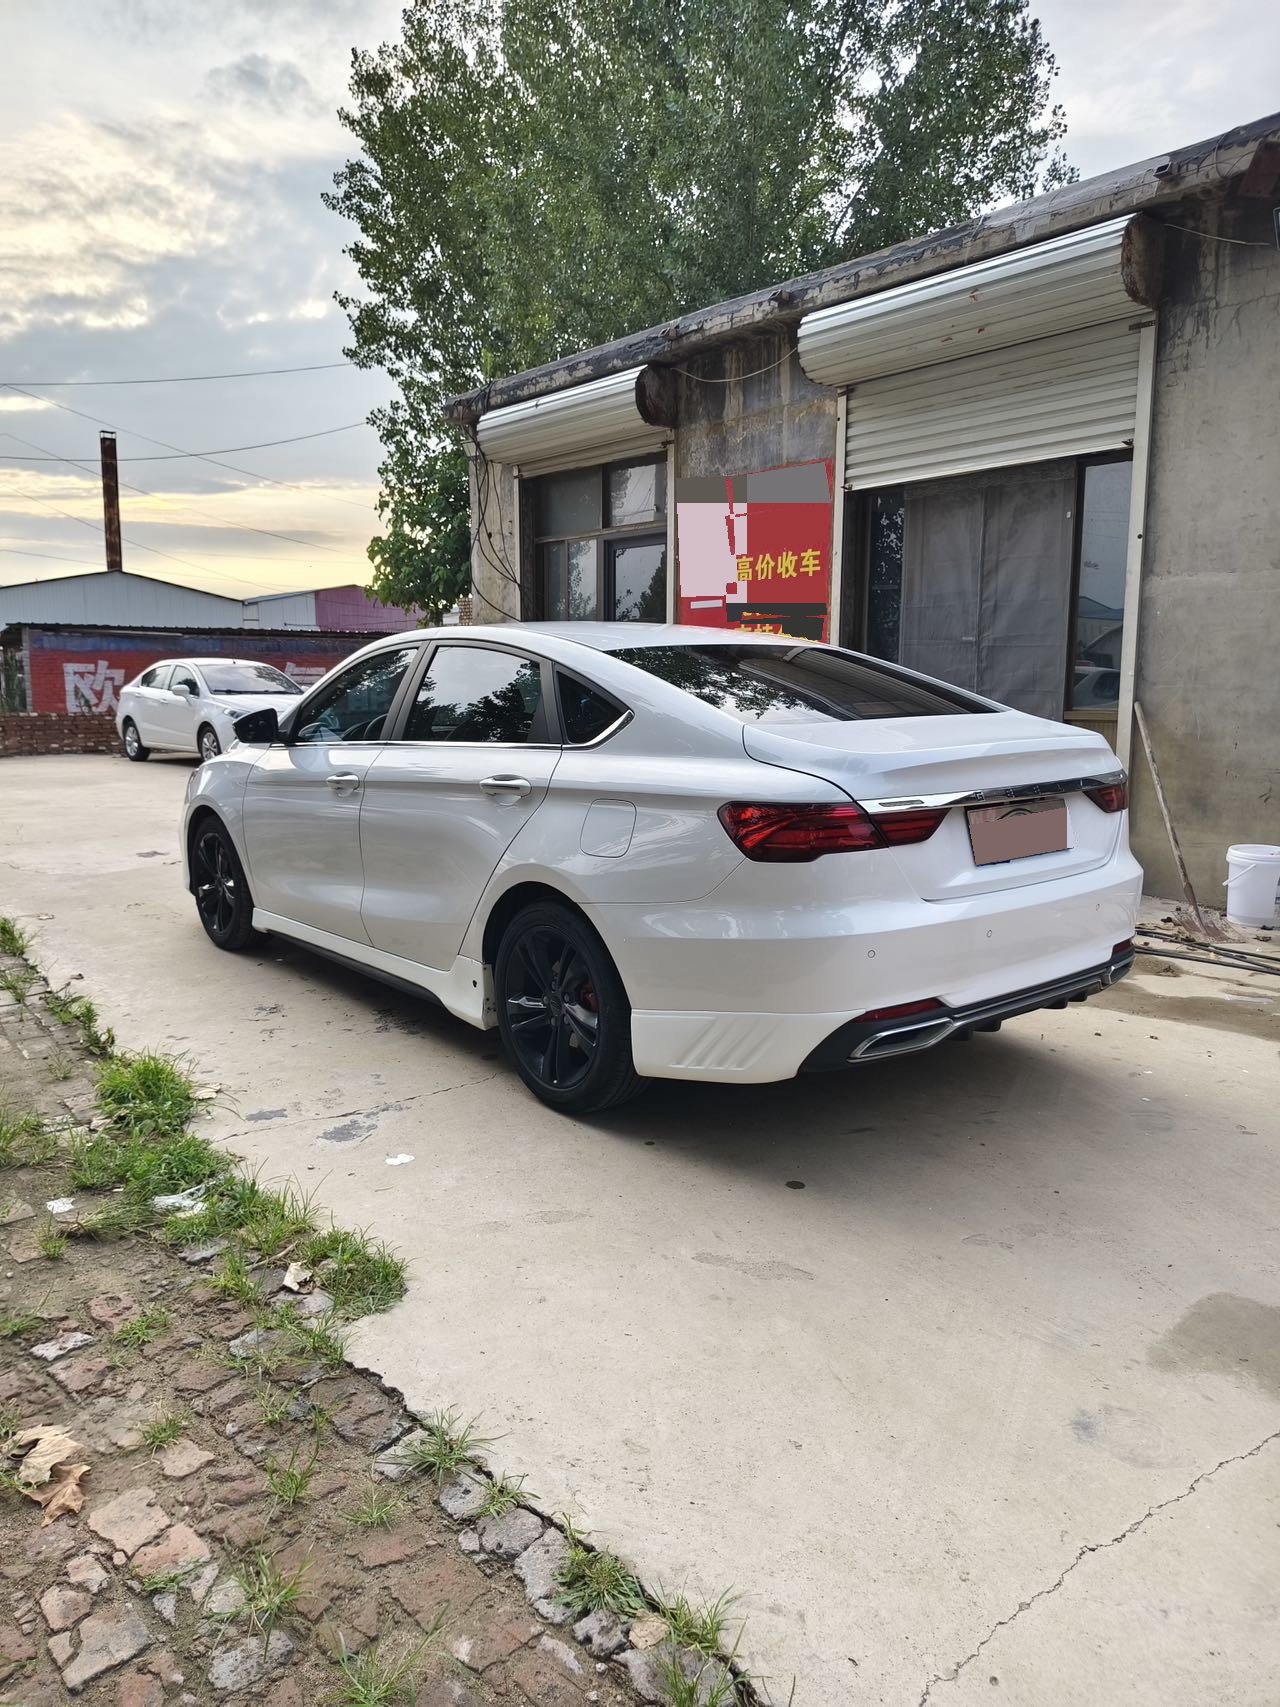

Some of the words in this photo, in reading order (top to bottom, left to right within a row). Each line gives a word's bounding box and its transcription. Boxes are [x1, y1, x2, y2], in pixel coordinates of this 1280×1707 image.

[736, 549, 821, 581] 高价收车
[63, 660, 126, 714] 欧
